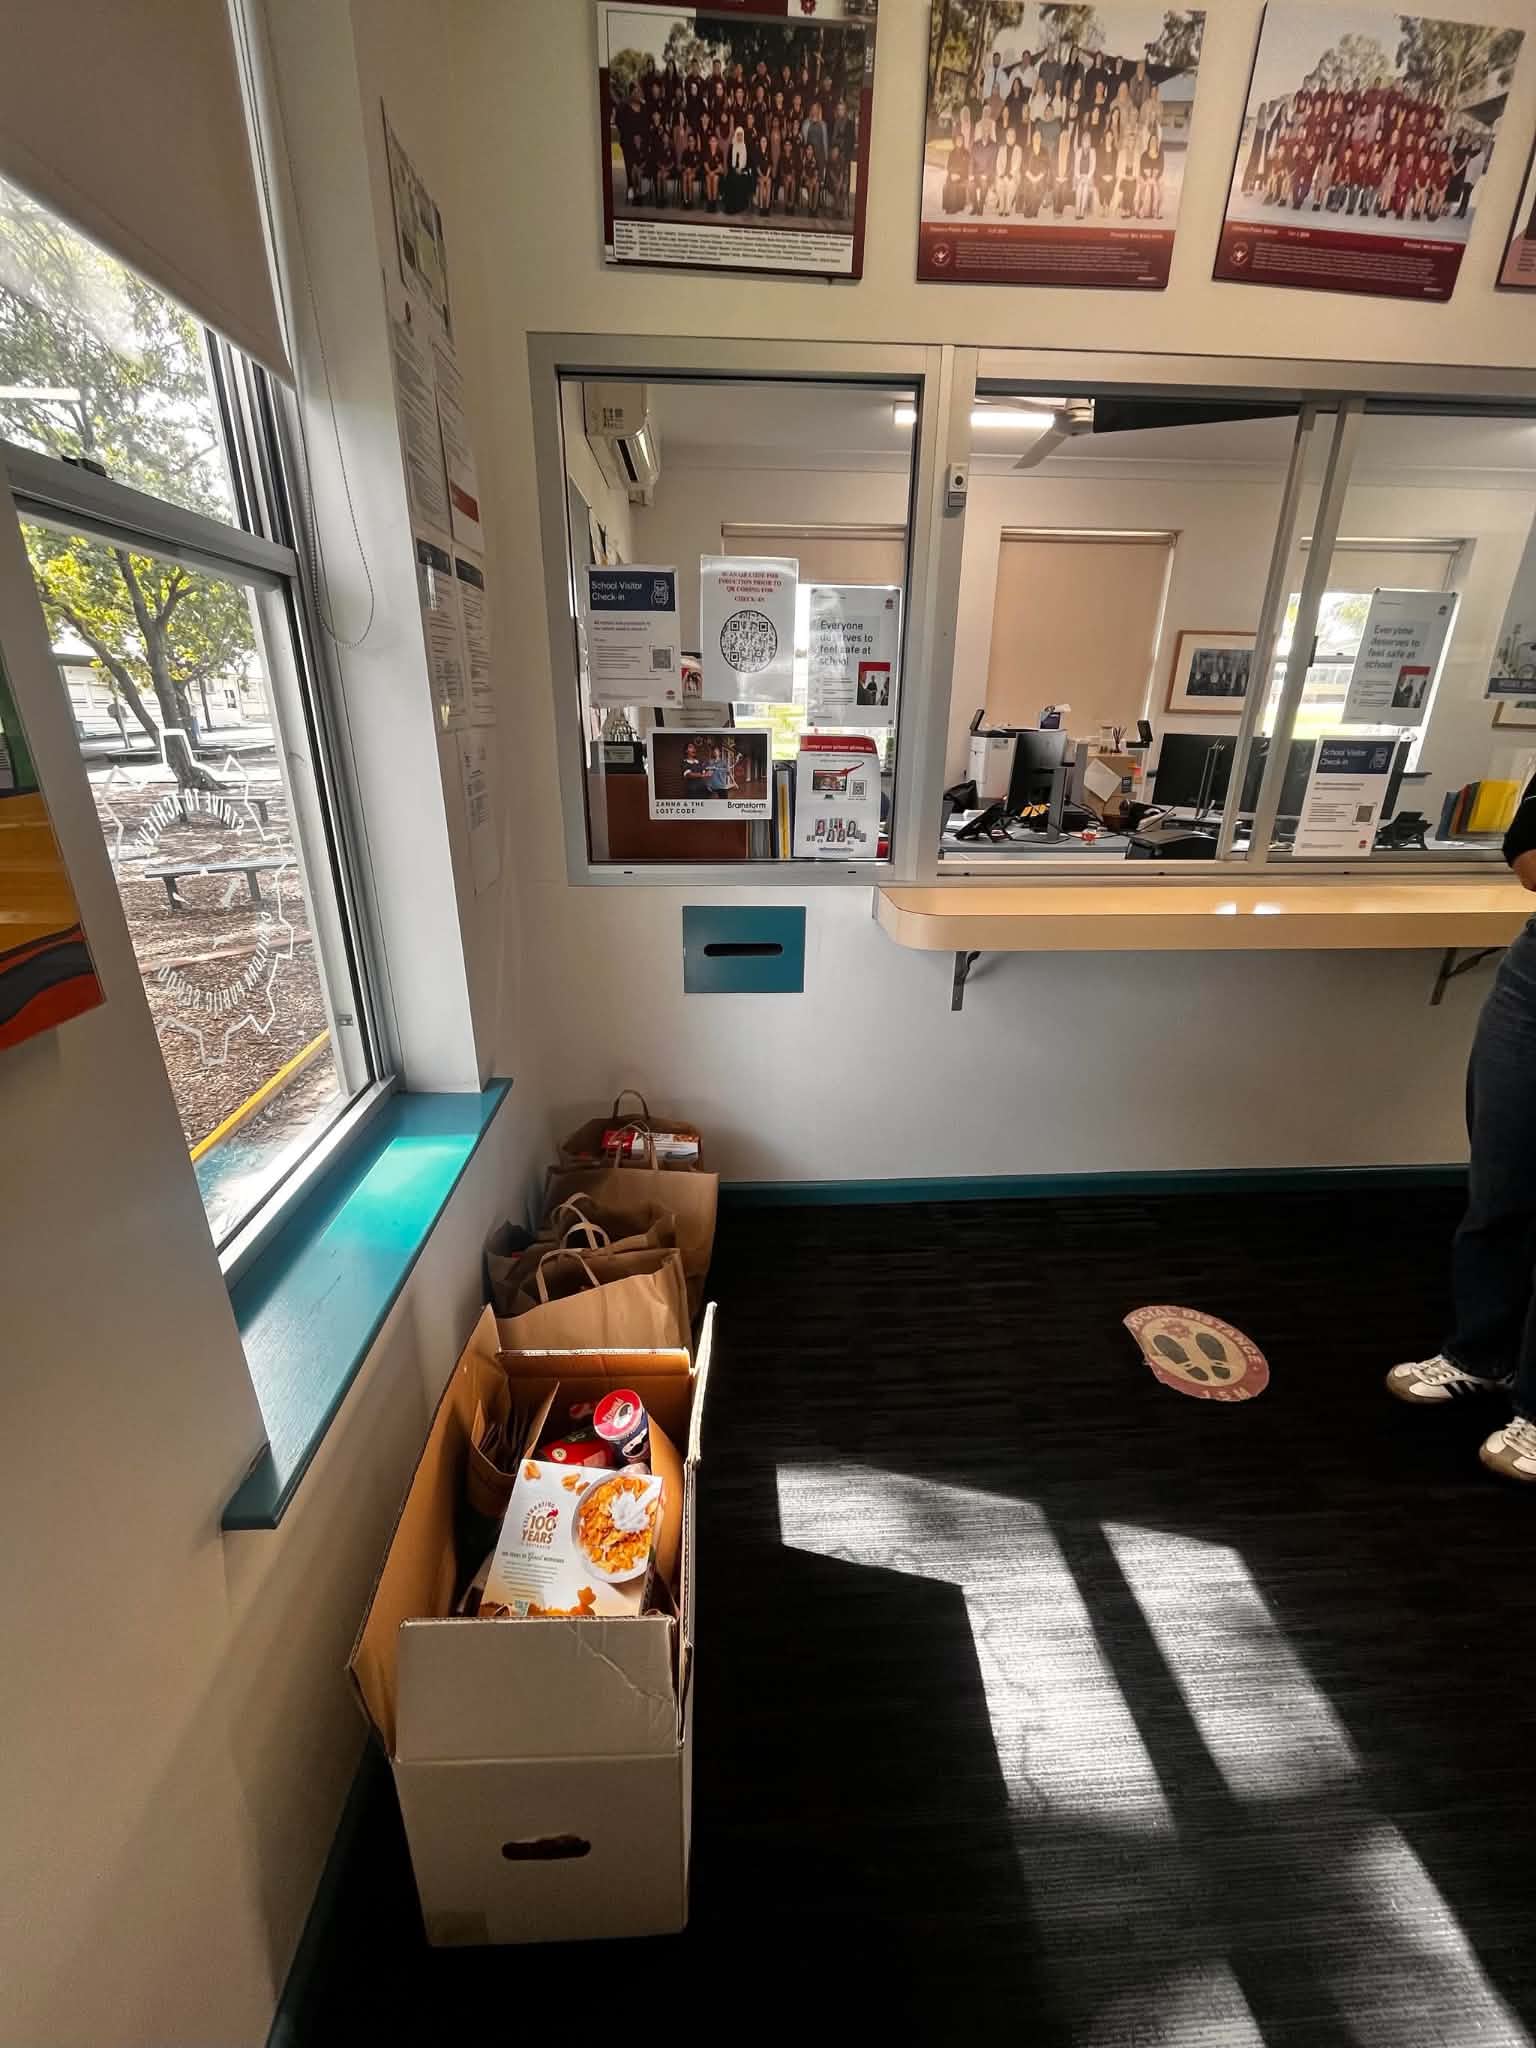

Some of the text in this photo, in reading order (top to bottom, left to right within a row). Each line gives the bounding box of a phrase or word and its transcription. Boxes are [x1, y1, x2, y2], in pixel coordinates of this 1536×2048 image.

[591, 580, 643, 590] School Visitor
[820, 619, 864, 632] Everyone
[1373, 624, 1415, 636] Everyone
[819, 632, 874, 643] derves to
[1411, 638, 1421, 648] to
[862, 645, 872, 655] at
[1367, 647, 1417, 659] feel safe at
[818, 656, 849, 665] school
[1364, 660, 1393, 670] school
[727, 801, 767, 809] Brainstorm
[530, 1515, 557, 1532] 100
[522, 1529, 554, 1545] YEARS
